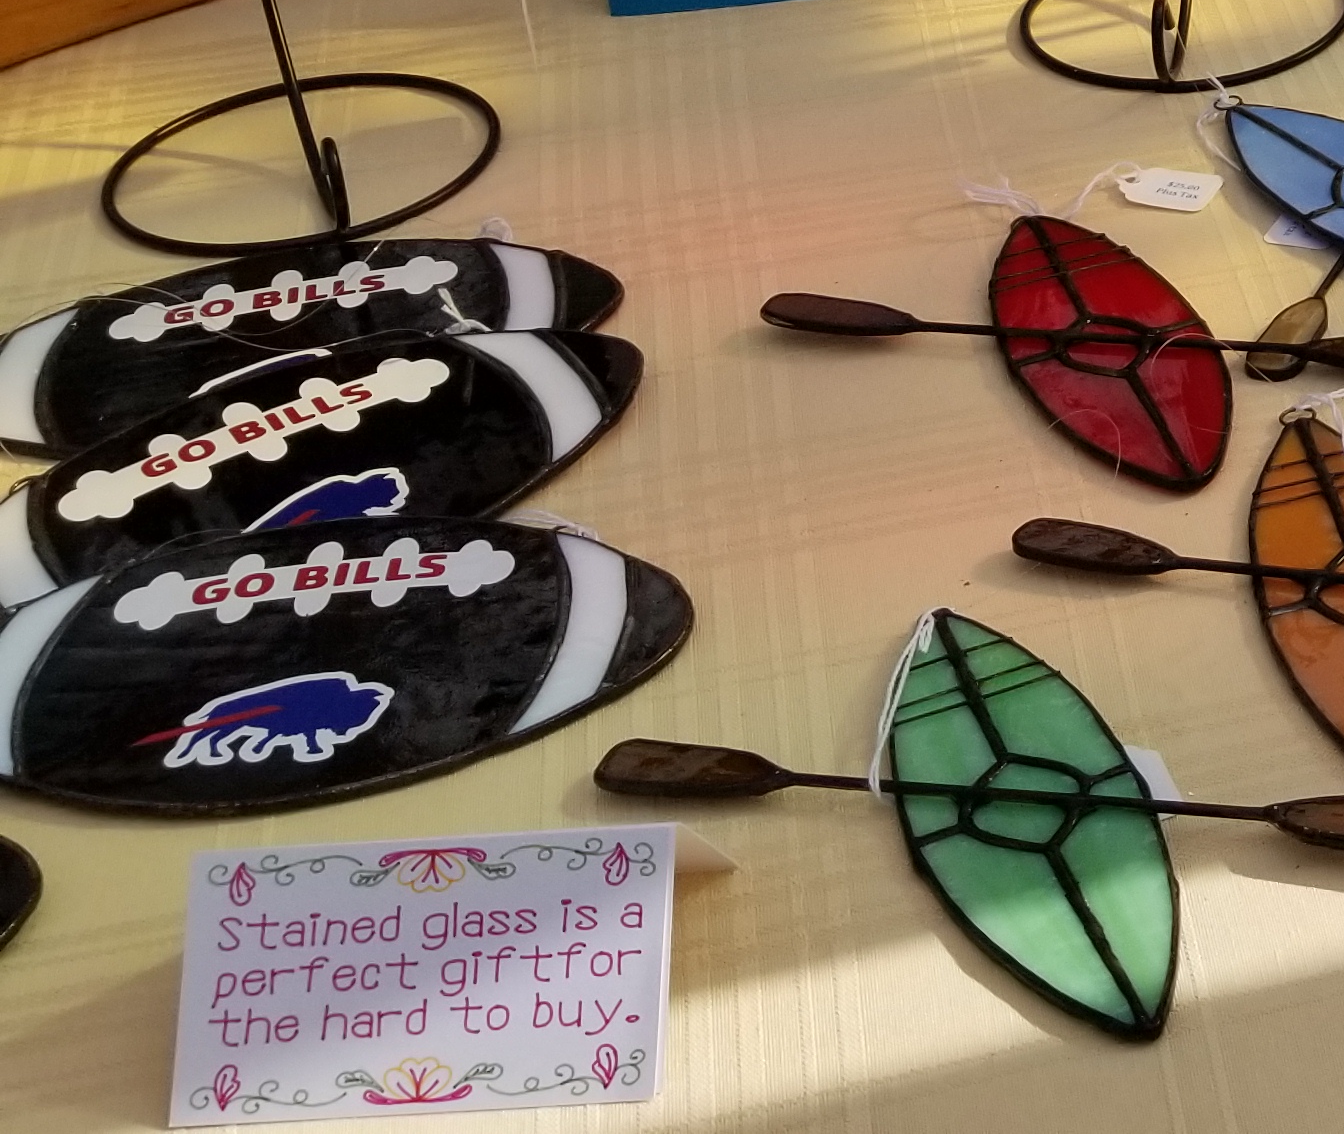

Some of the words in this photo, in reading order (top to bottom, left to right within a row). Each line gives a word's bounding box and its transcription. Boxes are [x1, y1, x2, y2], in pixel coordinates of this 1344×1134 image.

[1156, 188, 1177, 196] Plus
[1180, 191, 1199, 200] Tax
[164, 298, 235, 325] GO
[252, 274, 386, 310] BILLS
[140, 439, 216, 478] GO
[228, 382, 373, 445] BILLS
[191, 571, 275, 606] GO
[293, 553, 448, 592] BILLS
[217, 905, 402, 953] Stained
[422, 901, 538, 951] glass
[560, 898, 599, 933] is
[619, 901, 644, 930] a
[211, 952, 419, 1009] perfect
[208, 1008, 299, 1047] the
[320, 998, 428, 1042] hard
[449, 996, 510, 1034] to
[531, 991, 641, 1036] buy.
